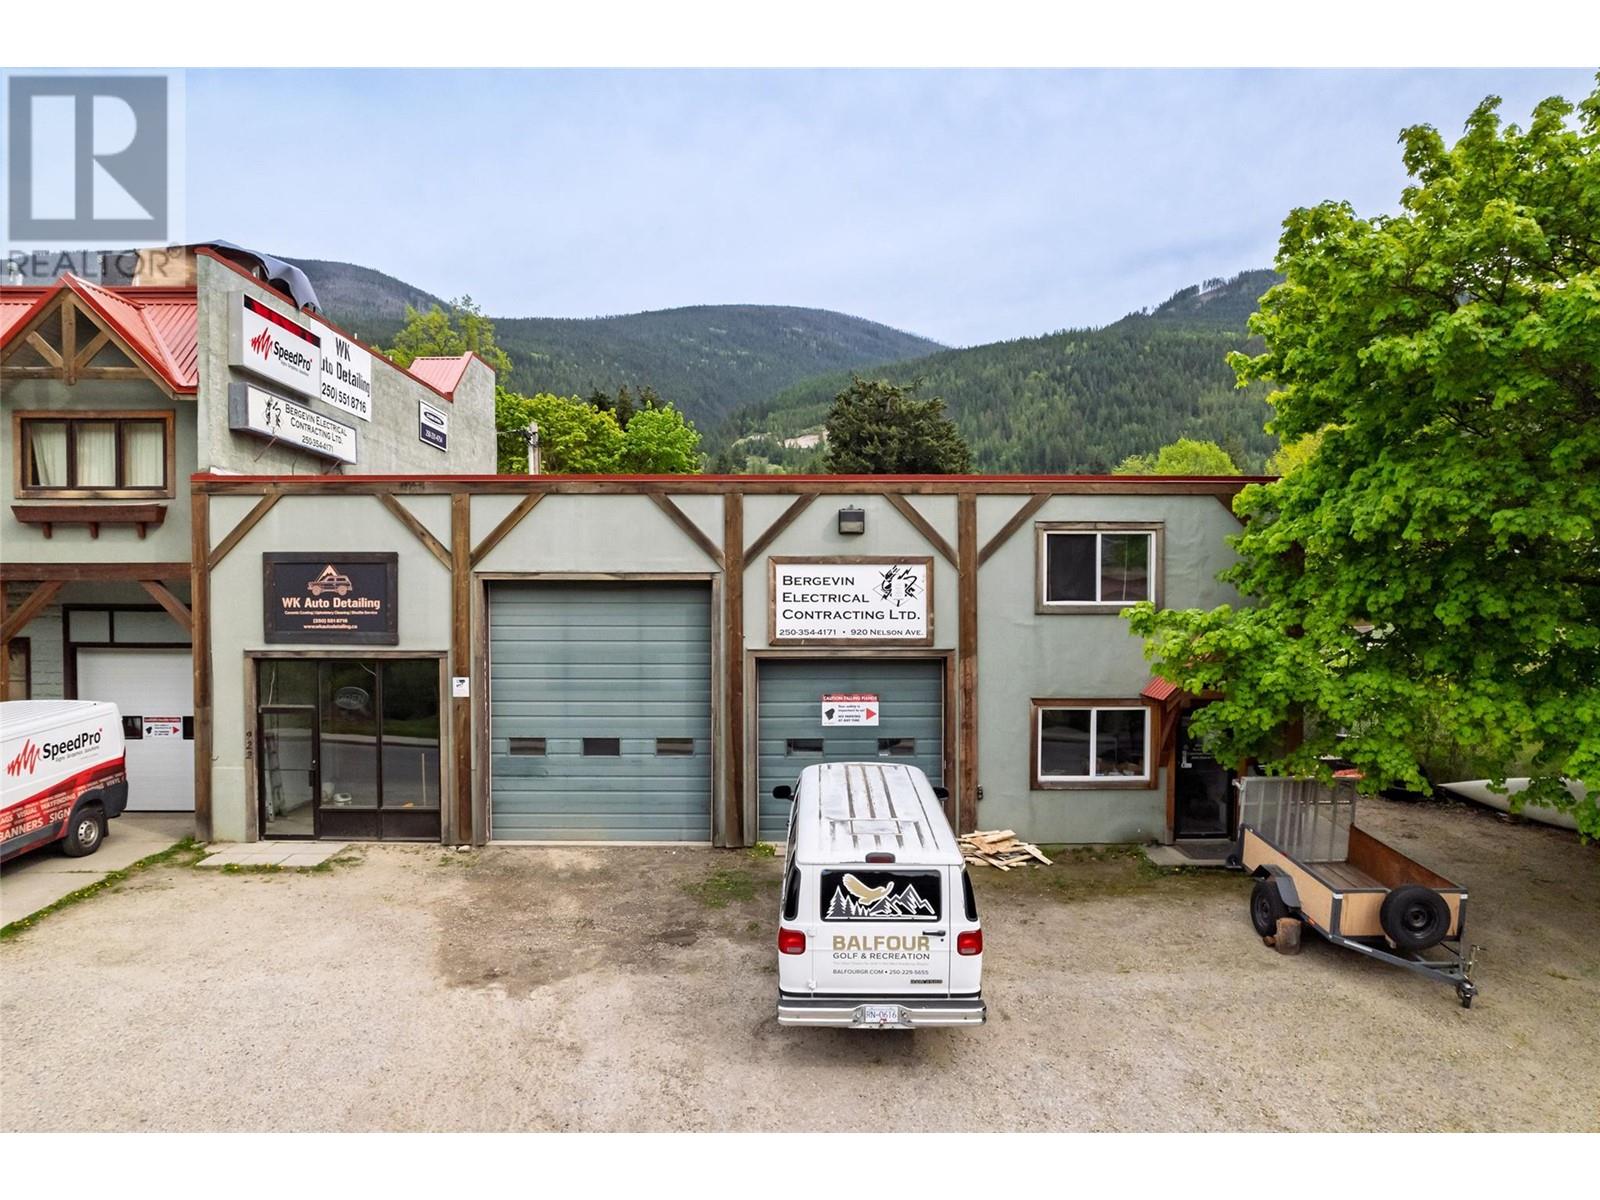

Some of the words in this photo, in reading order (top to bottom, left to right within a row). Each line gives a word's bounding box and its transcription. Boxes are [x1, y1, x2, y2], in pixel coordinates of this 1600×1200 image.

[273, 341, 311, 371] SpeedPro
[335, 337, 351, 362] WK
[336, 361, 370, 398] Detailing
[338, 391, 350, 406] 551
[351, 397, 367, 414] 8716
[285, 403, 315, 423] BERGEVIN
[316, 416, 347, 437] ELECTRICAL
[290, 417, 331, 440] CONTRACTING
[782, 575, 855, 586] BERGEVIN
[282, 597, 301, 608] WK
[304, 597, 330, 608] Auto
[333, 597, 381, 610] Detailing
[782, 592, 870, 603] ELECTRICAL
[782, 609, 885, 620] CONTRACTING
[889, 609, 921, 620] LTD.
[43, 732, 101, 761] SpeedPro
[832, 935, 930, 951] BALFOUR
